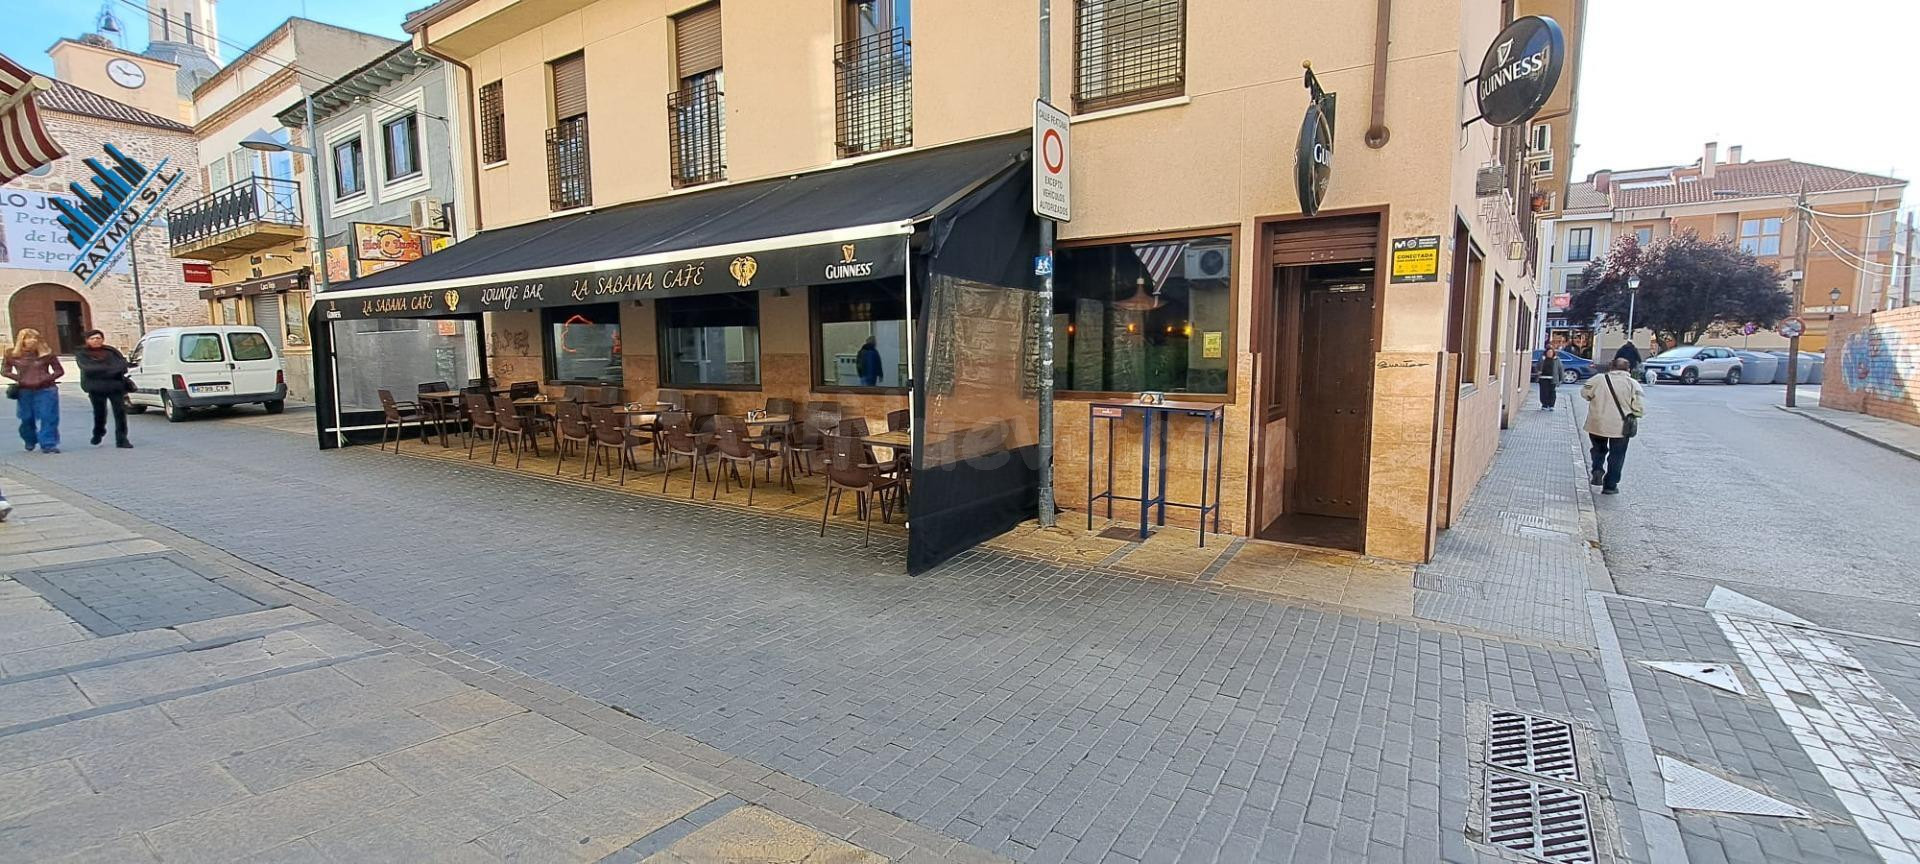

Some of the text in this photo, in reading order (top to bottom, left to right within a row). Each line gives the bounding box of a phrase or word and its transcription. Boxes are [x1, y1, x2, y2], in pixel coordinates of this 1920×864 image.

[1480, 53, 1542, 100] GUINNESS
[24, 229, 46, 242] de
[571, 261, 873, 300] LA SABANA CAFÉ GUINNESS
[362, 300, 373, 316] LA
[375, 298, 407, 313] SABANA
[481, 283, 544, 309] LOUNGE BAR
